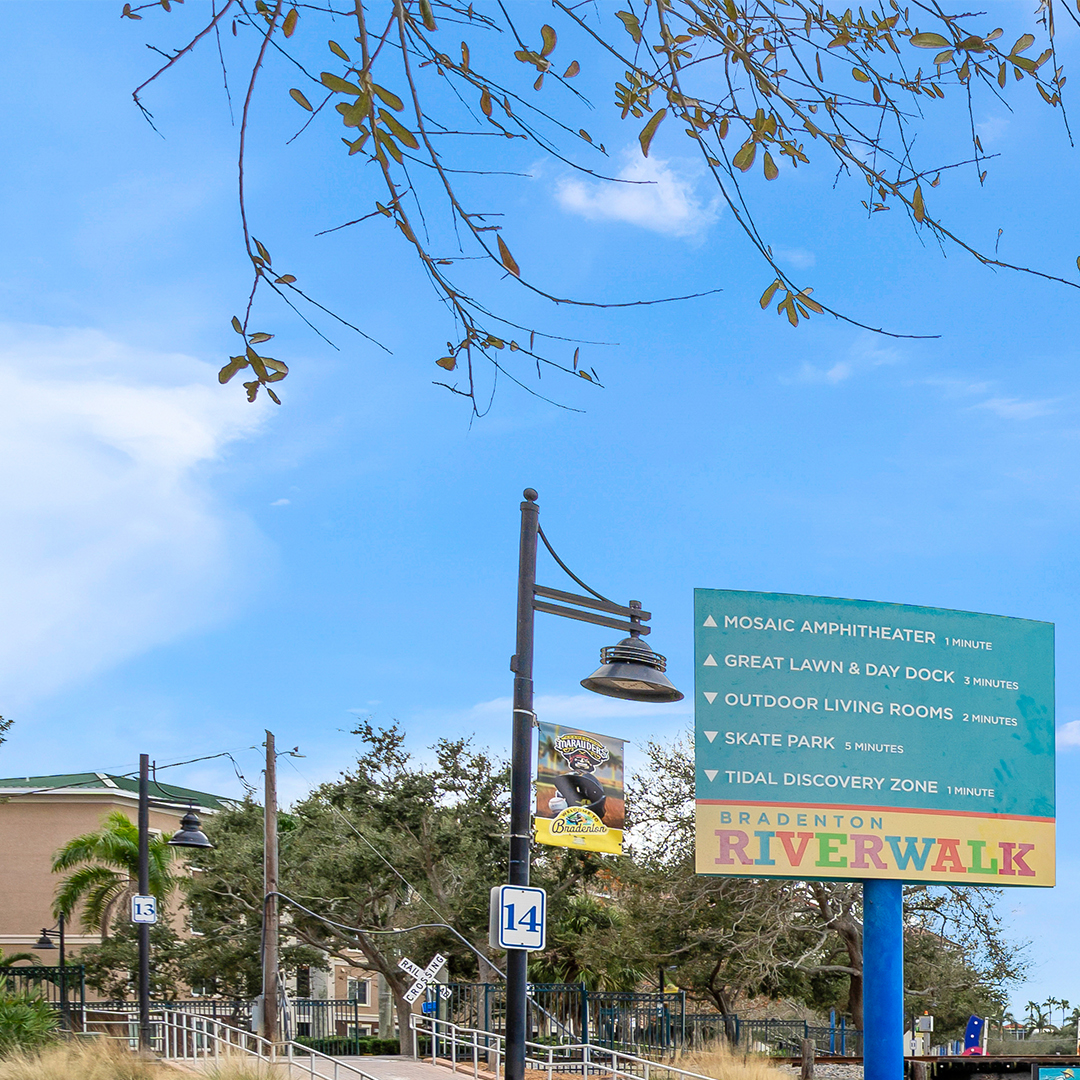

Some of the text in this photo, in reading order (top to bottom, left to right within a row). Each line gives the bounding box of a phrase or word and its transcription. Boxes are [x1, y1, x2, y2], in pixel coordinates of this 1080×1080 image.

[724, 615, 993, 651] MOSAIC AMPHITHEATER 1 MINUTE
[724, 654, 1019, 690] GREAT LAWN & DAY DOCK 3 MINUTES
[724, 692, 1018, 727] OUTDOOR LIVING ROOMS 2 MINUTES
[557, 738, 608, 758] MARAUDERS
[724, 731, 904, 754] SKATE PARK 5 MINUTES
[725, 770, 995, 798] TIDAL DISCOVERY ZONE 1 MINUTE
[562, 808, 592, 817] WELCOME
[720, 811, 884, 830] BRADENTON
[552, 818, 607, 833] Bradenton
[714, 830, 1036, 877] RIVERWALK
[135, 902, 155, 916] 13
[503, 903, 542, 933] 14
[401, 960, 420, 977] RAIL
[406, 956, 444, 1001] CROSSING
